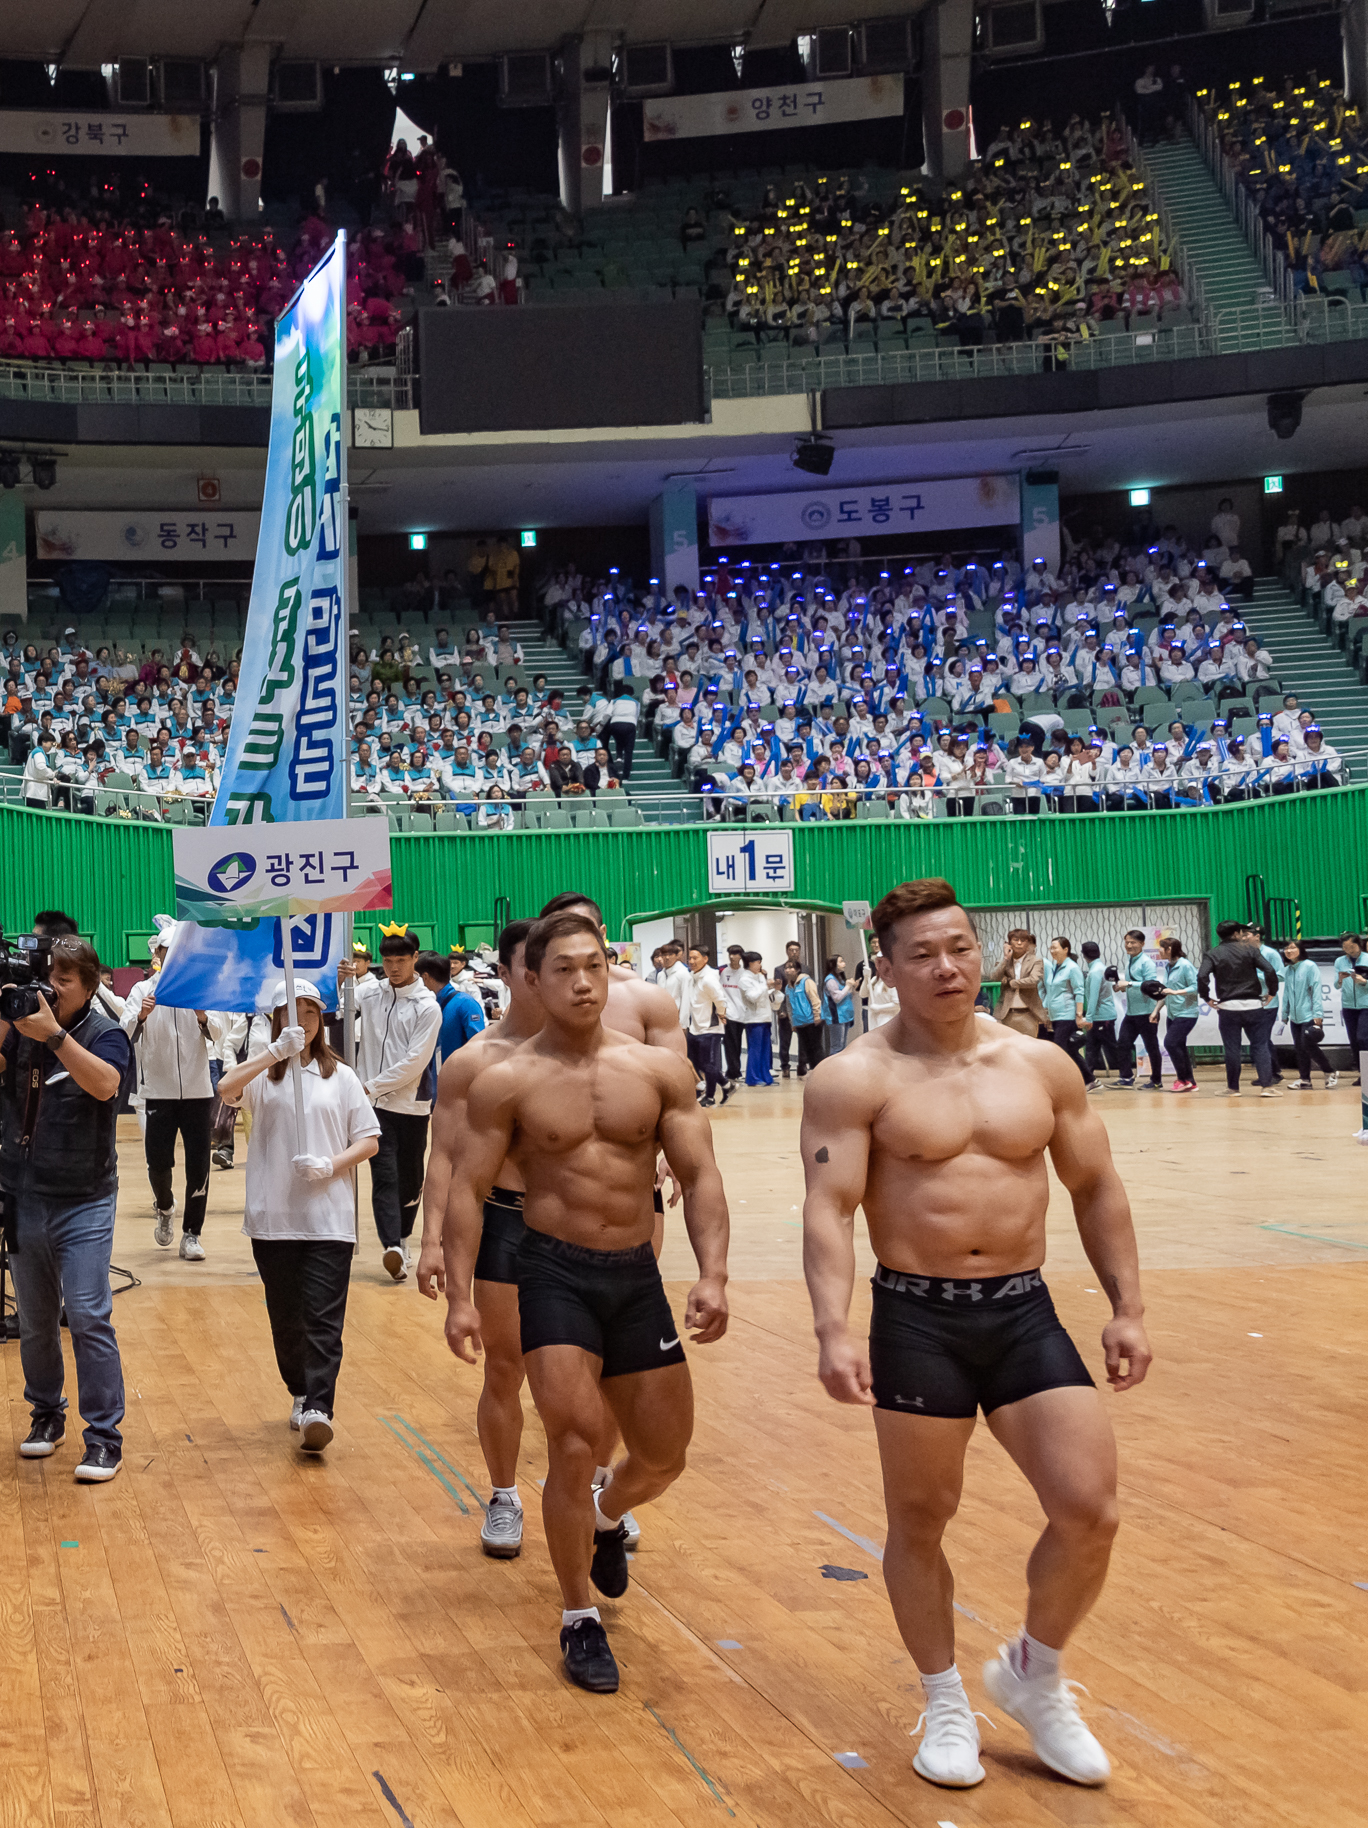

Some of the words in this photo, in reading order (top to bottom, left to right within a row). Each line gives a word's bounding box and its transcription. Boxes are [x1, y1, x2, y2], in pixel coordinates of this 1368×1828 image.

[751, 91, 826, 121] 양천구
[61, 122, 129, 145] 강북구
[837, 495, 925, 524] 도봉구
[1033, 506, 1049, 527] 5
[158, 523, 237, 549] 동작구
[673, 530, 688, 551] 5
[1, 540, 19, 561] 4
[288, 585, 341, 801] 만드는
[265, 850, 360, 888] 광진구
[32, 1068, 40, 1089] EOS
